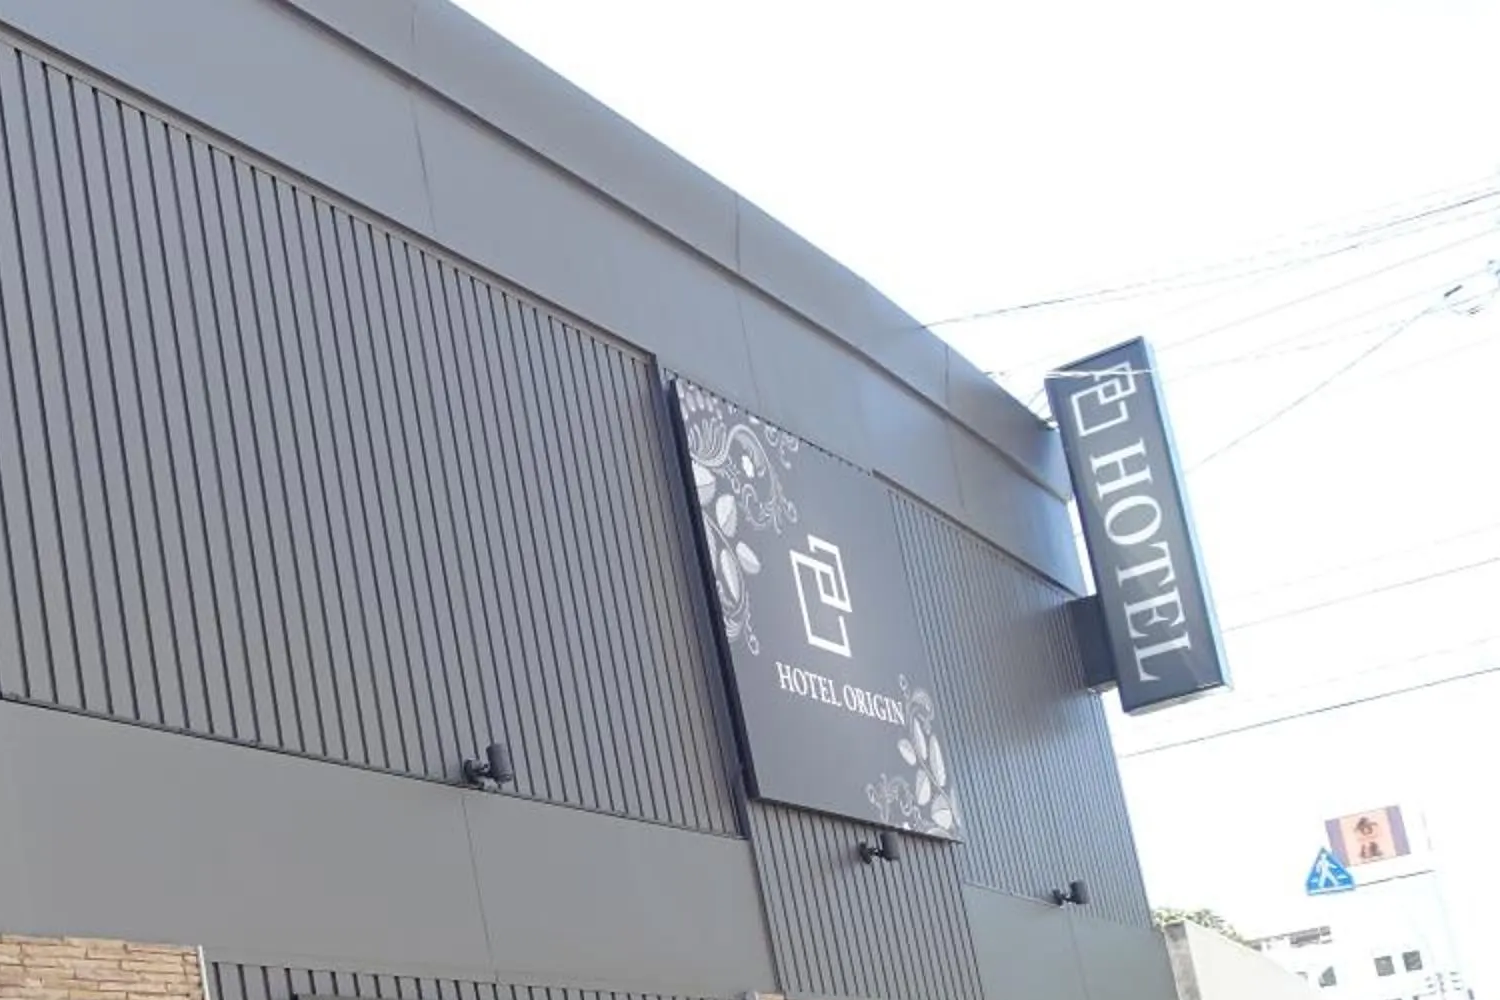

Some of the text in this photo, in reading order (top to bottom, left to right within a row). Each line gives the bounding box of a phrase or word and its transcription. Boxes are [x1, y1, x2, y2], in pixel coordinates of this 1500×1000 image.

[1090, 439, 1192, 682] HOTEL
[776, 661, 905, 725] HOTEL ORIGIN
